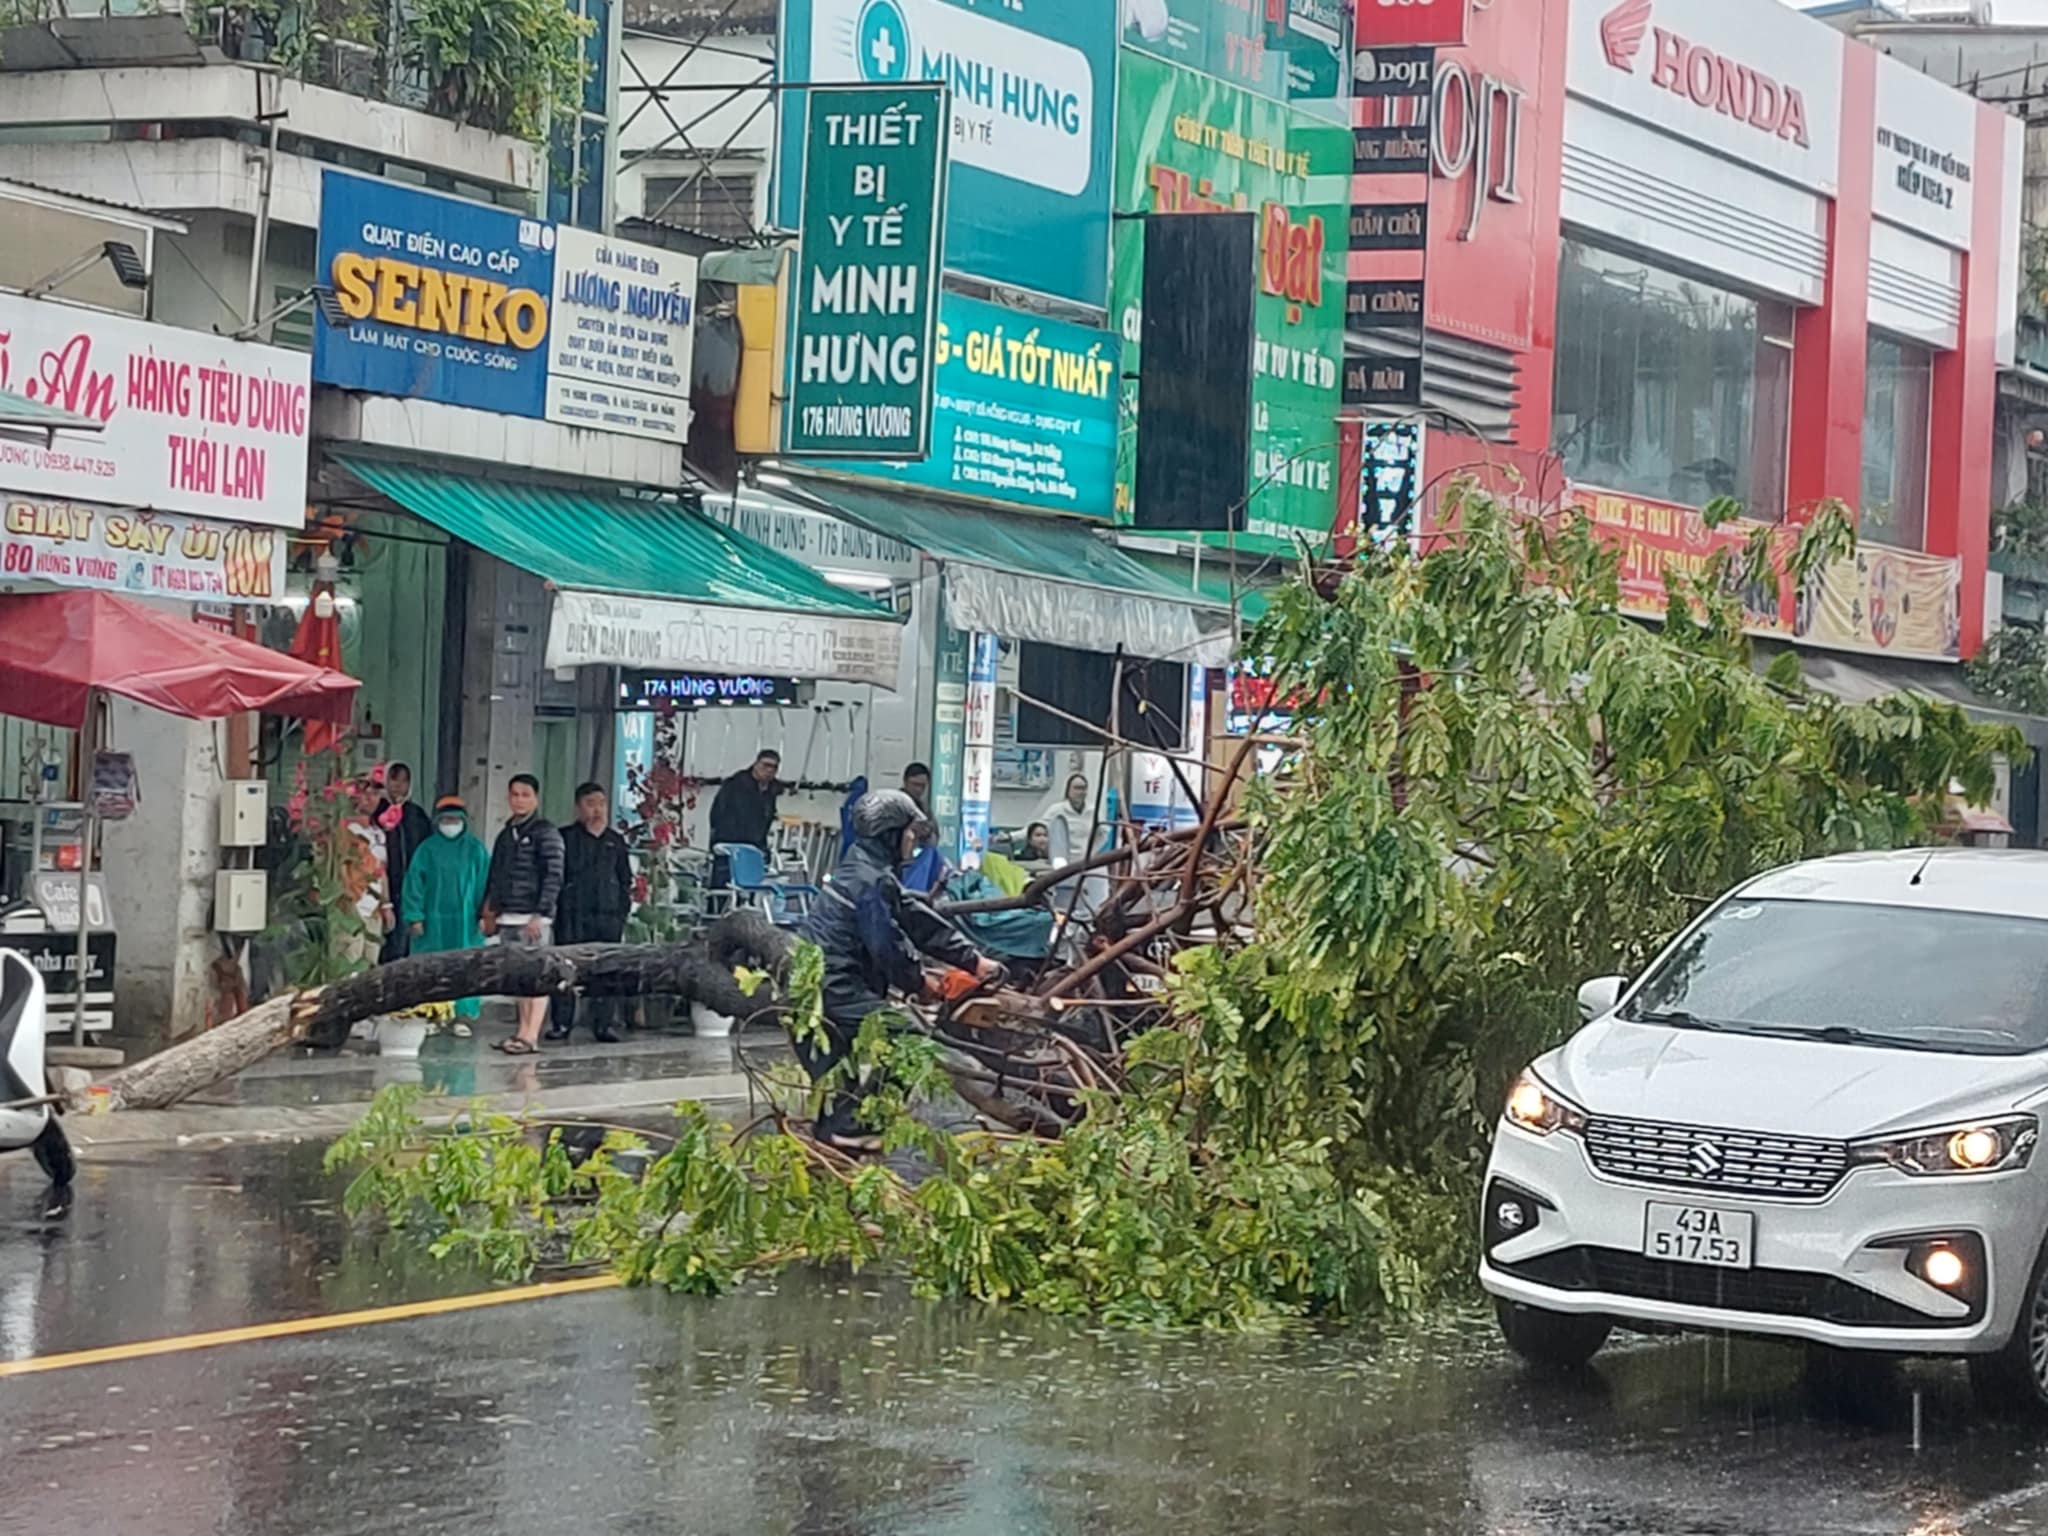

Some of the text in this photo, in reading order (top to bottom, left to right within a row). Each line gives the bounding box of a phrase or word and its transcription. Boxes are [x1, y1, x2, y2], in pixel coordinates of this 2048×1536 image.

[922, 46, 993, 109] MINH
[1379, 61, 1428, 88] DOJI
[1652, 26, 1810, 149] HONDA
[825, 102, 922, 146] THIẾT
[1431, 60, 1527, 241] OJI
[854, 165, 886, 202] BỊ
[829, 203, 908, 246] Y TẾ
[362, 223, 519, 274] QUẠT ĐIỆN CAO CẤP
[332, 252, 547, 350] SENKO
[561, 269, 621, 312] LƯƠNG
[811, 264, 917, 316] MINH
[413, 341, 442, 359] CHO
[802, 332, 917, 385] HƯNG
[966, 325, 1005, 379] GIÁ
[1007, 328, 1051, 387] TỐT
[1053, 342, 1113, 398] NHẤT
[127, 344, 305, 436] HÀNG TIÊU DÙNG
[803, 406, 823, 437] 176
[825, 397, 862, 437] HÙNG
[865, 405, 912, 438] VƯƠNG
[168, 428, 217, 495] THÁI
[223, 445, 266, 501] LAN
[5, 500, 94, 545] GIẶT
[818, 522, 839, 557] 176
[4, 543, 33, 573] 80
[668, 609, 739, 665] TÂM
[745, 619, 818, 671] TIẾN
[671, 674, 715, 697] HÙNG
[719, 675, 774, 696] VƯƠNG
[1676, 1207, 1722, 1236] 43A
[1655, 1232, 1741, 1264] 517.53
